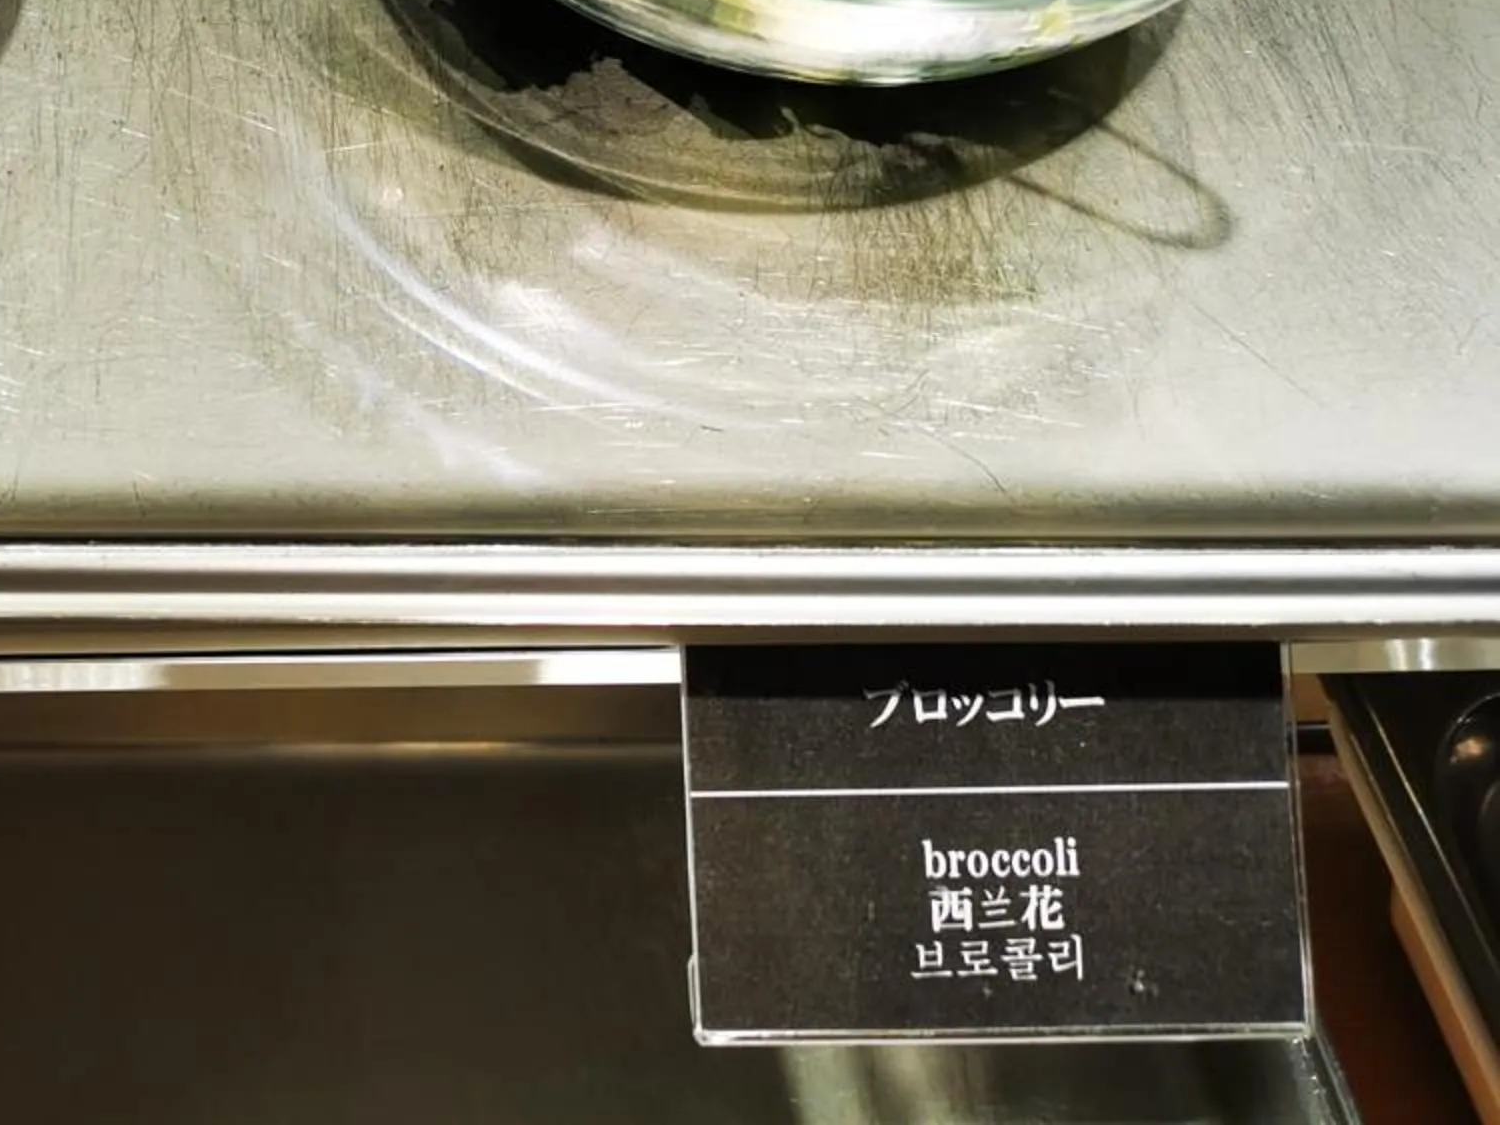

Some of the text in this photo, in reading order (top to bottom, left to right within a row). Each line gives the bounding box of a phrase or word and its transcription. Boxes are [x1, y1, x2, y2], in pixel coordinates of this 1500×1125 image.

[862, 679, 1106, 728] ブロッコリー
[922, 837, 1080, 878] broccoli
[930, 885, 1064, 932] 西兰花
[911, 934, 1083, 981] 브로콜리
